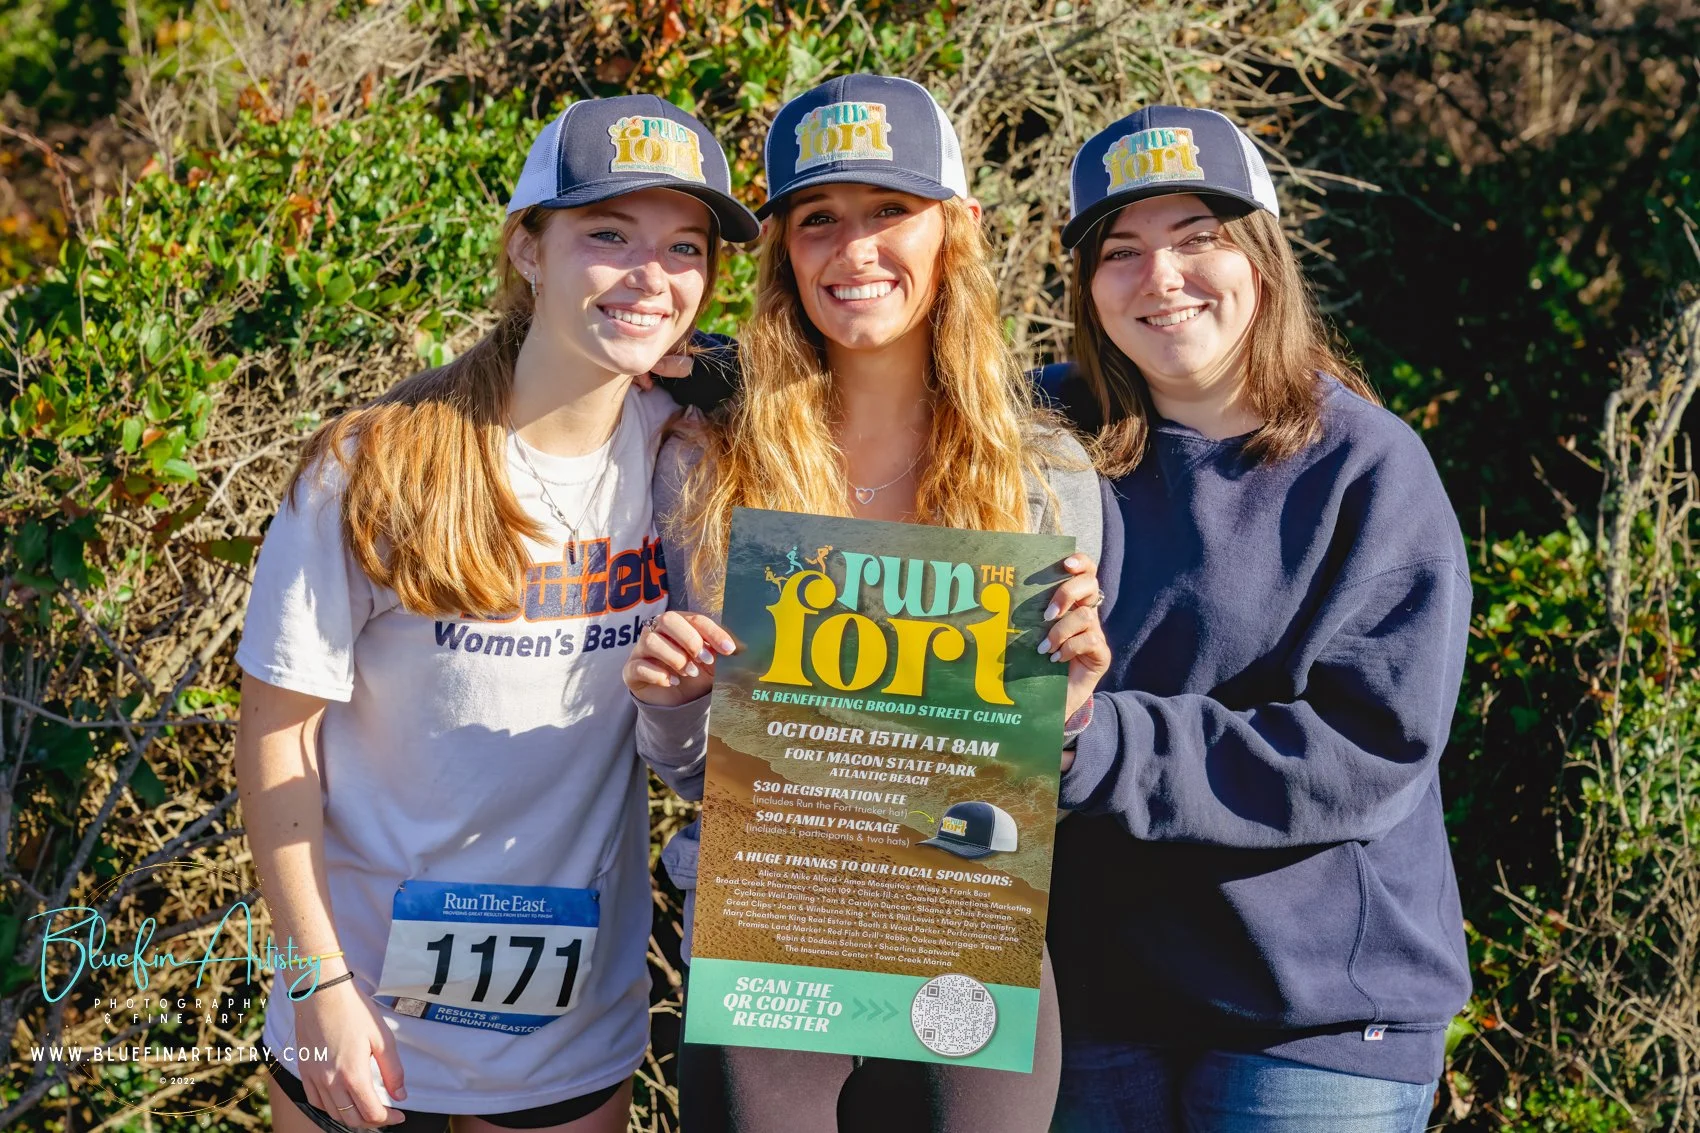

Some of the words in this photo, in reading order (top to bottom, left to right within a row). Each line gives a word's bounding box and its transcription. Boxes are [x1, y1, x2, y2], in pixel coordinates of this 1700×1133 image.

[460, 536, 668, 623] ullets
[837, 551, 979, 617] run
[981, 564, 1015, 587] THE
[435, 620, 575, 657] Women's
[582, 615, 648, 653] Bask
[759, 569, 1022, 705] fort
[752, 689, 771, 702] 5K
[772, 691, 864, 710] BENEFITTING
[866, 700, 916, 715] BROAD
[918, 705, 972, 720] STREET
[973, 710, 1022, 725] CLINIC
[767, 721, 865, 744] OCTOBER
[869, 730, 918, 749] 15TH
[920, 735, 950, 752] AT
[951, 738, 1000, 758] 8AM
[785, 747, 825, 762] FORT
[827, 752, 884, 768] MACON
[886, 757, 934, 773] STATE
[935, 762, 977, 777] PARK
[830, 767, 887, 782] ATLANTIC
[889, 773, 929, 786] BEACH
[752, 794, 794, 808] (includes
[796, 799, 813, 808] Run
[816, 801, 831, 810] the
[833, 802, 852, 812] Fort
[855, 804, 886, 815] trucker
[889, 807, 908, 818] hat)
[753, 780, 781, 794] $30
[783, 783, 883, 803] REGISTRATION
[884, 793, 908, 805] FEE
[746, 823, 787, 837] (includes
[799, 828, 854, 842] participants
[857, 834, 863, 842] &
[867, 835, 884, 843] two
[886, 836, 910, 848] hats)
[756, 810, 784, 824] $90
[786, 813, 836, 828] FAMILY
[837, 818, 901, 834] PACKAGE
[734, 850, 744, 861] A
[746, 852, 783, 864] HUGE
[785, 855, 837, 870] THANKS
[840, 860, 858, 871] TO
[861, 862, 889, 874] OUR
[892, 865, 933, 879] LOCAL
[936, 869, 1013, 887] SPONSORS:
[759, 869, 781, 878] Alicia
[791, 873, 811, 881] Mike
[813, 874, 837, 883] Alford
[844, 877, 866, 886] Amos
[868, 880, 911, 891] Mosquito's
[917, 885, 940, 894] Missy
[950, 888, 972, 896] Frank
[974, 890, 991, 898] Best
[716, 876, 740, 885] Broad
[741, 879, 765, 887] Creek
[767, 881, 806, 892] Pharmacy
[813, 885, 837, 893] Catch
[857, 889, 900, 900] Chick-fil-A
[906, 894, 938, 903] Coastal
[939, 897, 989, 908] Connections
[991, 903, 1032, 914] Marketing
[734, 889, 766, 899] Cyclone
[787, 893, 815, 903] Drilling
[848, 899, 879, 909] Carolyn
[881, 902, 911, 911] Duncan
[917, 905, 945, 914] Sloane
[954, 909, 975, 917] Chris
[977, 911, 1012, 921] Freeman
[723, 909, 744, 917] Mary
[746, 910, 787, 920] Cheatham
[789, 914, 806, 923] King
[808, 916, 826, 924] Real
[827, 918, 852, 926] Estate
[858, 921, 881, 929] Booth
[891, 924, 913, 932] Wood
[915, 926, 940, 935] Parker
[947, 929, 998, 940] Performance
[1000, 934, 1019, 943] Zone
[727, 898, 749, 906] Great
[751, 901, 772, 909] Clips
[778, 903, 797, 911] Joan
[806, 905, 844, 915] Winburne
[846, 909, 863, 918] King
[913, 915, 935, 924] Lewis
[941, 918, 961, 927] Mary
[964, 921, 979, 929] Day
[980, 922, 1016, 933] Dentistry
[738, 920, 770, 929] Promise
[772, 923, 791, 931] Land
[793, 925, 822, 934] Market
[828, 928, 842, 936] Red
[862, 931, 879, 939] Grill
[885, 934, 909, 943] Robby
[912, 936, 937, 945] Oakes
[939, 939, 978, 950] Mortgage
[980, 943, 1002, 951] Team
[777, 934, 799, 942] Robin
[808, 937, 838, 945] Dodson
[840, 939, 873, 949] Schenck
[879, 943, 917, 953] Shearline
[919, 947, 960, 957] Boatworks
[427, 933, 582, 1008] 1171
[801, 946, 840, 956] Insurance
[842, 950, 868, 959] Center
[875, 953, 896, 961] Town
[898, 955, 925, 964] Creek
[927, 958, 952, 967] Marina
[736, 976, 791, 995] SCAN
[795, 981, 834, 999] THE
[437, 1007, 486, 1020] RESULTS
[723, 992, 753, 1013] QR
[756, 995, 812, 1014] CODE
[816, 1000, 843, 1017] TO
[435, 1014, 542, 1033] LIVE.RUNTHEEAST.CO
[733, 1010, 830, 1033] REGISTER
